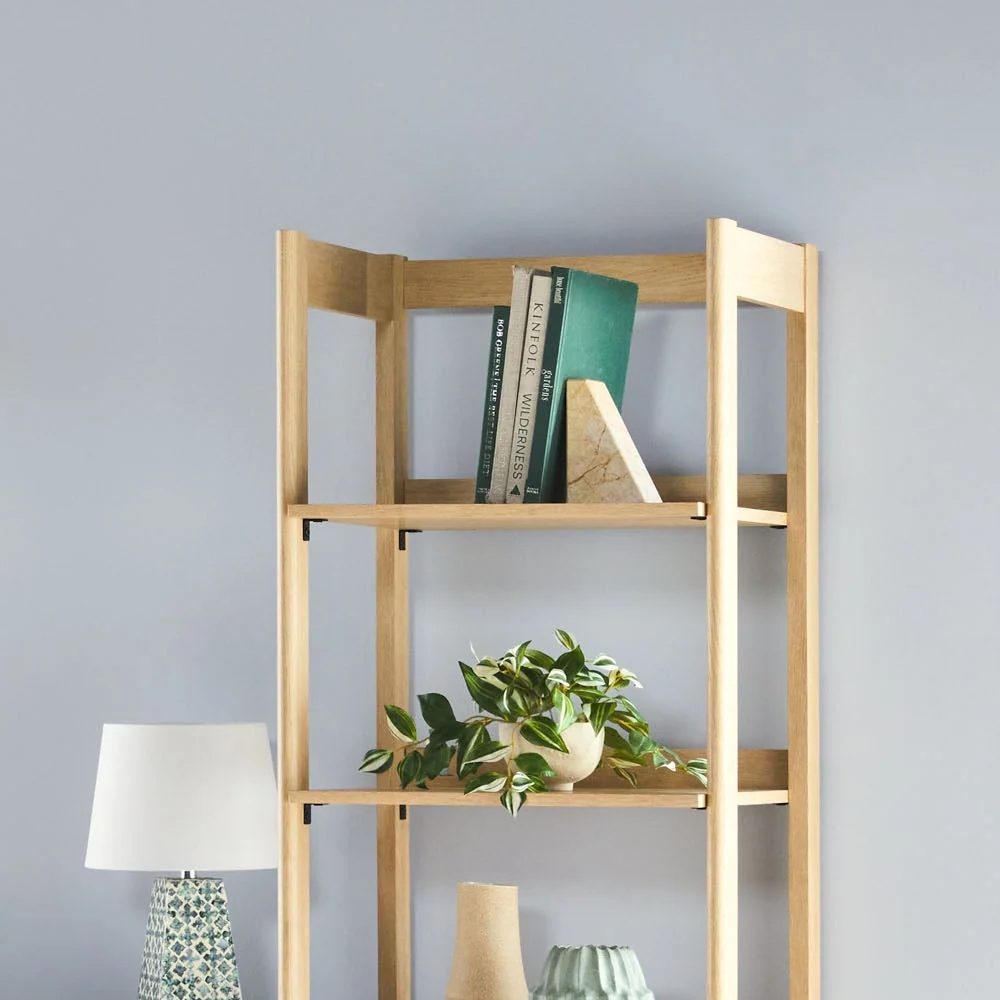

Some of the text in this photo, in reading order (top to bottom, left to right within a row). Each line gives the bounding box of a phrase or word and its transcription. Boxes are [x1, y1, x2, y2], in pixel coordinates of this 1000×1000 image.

[496, 319, 504, 337] BOB
[513, 303, 543, 479] KINFOLK WILDERNESS
[541, 369, 553, 401] gardens
